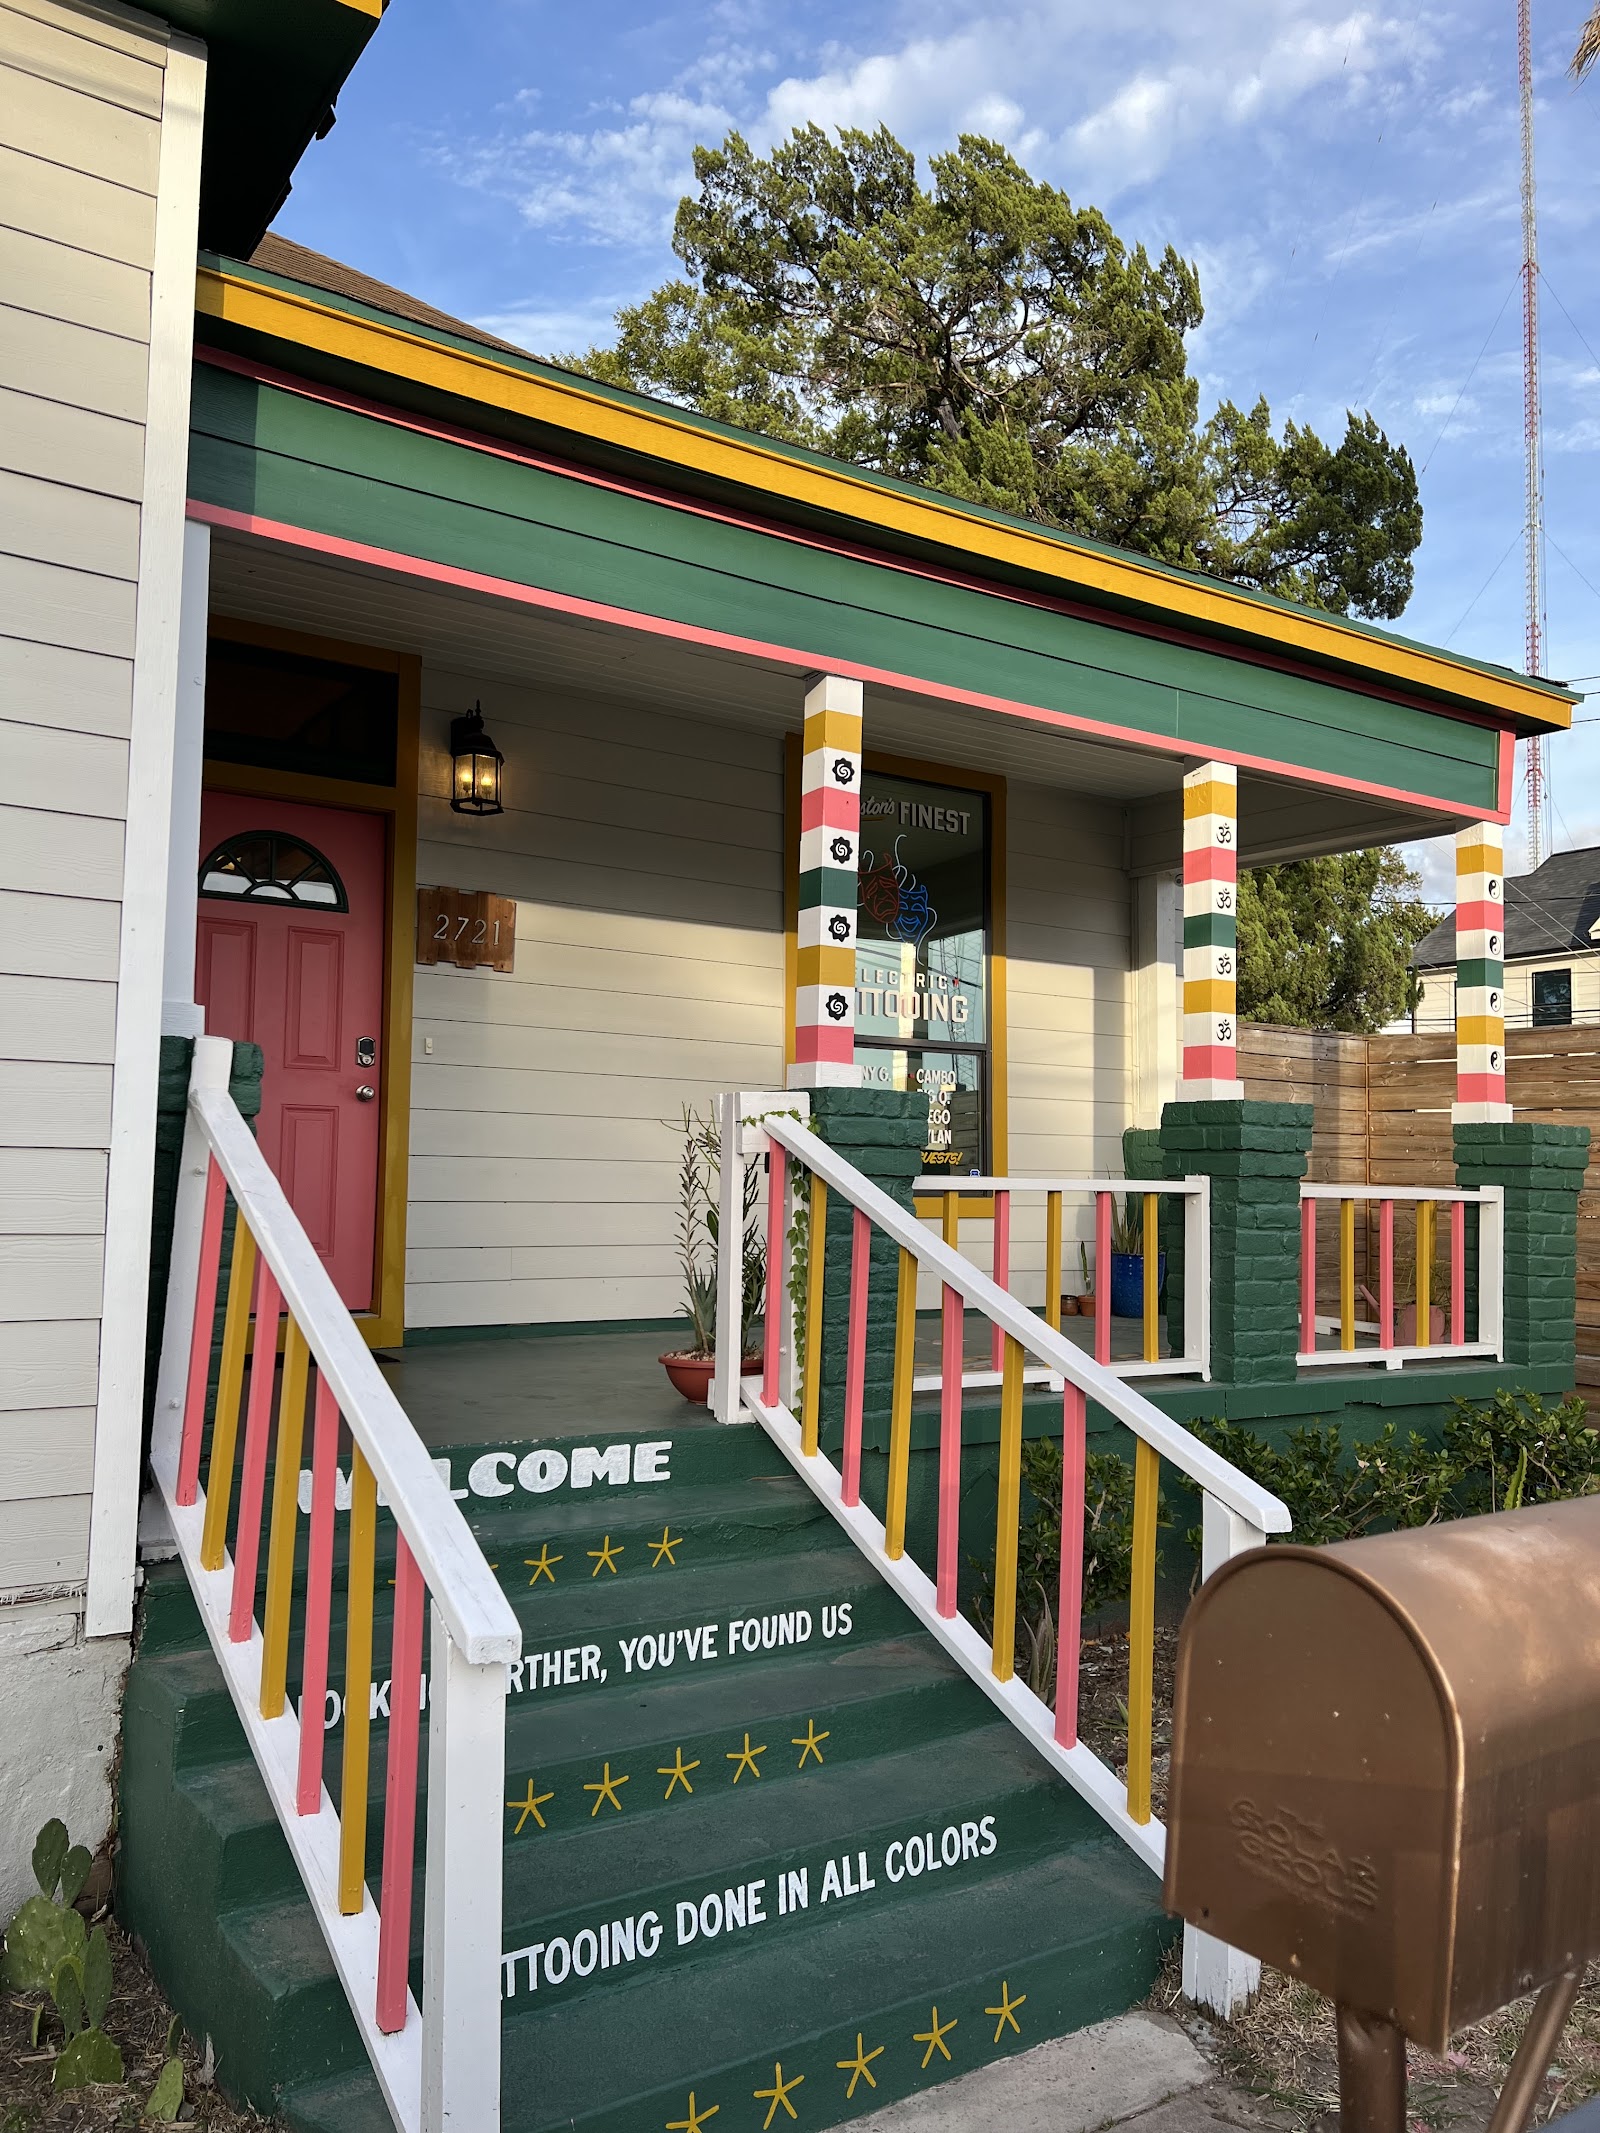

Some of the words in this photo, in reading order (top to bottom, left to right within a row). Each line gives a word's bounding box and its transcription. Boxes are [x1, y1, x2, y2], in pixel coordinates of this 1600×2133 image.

[860, 796, 895, 815] ston's
[899, 801, 971, 835] FINEST
[433, 914, 500, 946] 2721
[856, 968, 948, 990] LECTRIC
[855, 987, 969, 1023] TTOOING
[878, 1066, 892, 1081] G.
[916, 1068, 956, 1085] CAMBO
[928, 1109, 951, 1125] EGO
[298, 1441, 673, 1515] WLCOME
[506, 1644, 608, 1694] RTHER,
[618, 1624, 719, 1673] YOU'VE
[728, 1610, 812, 1654] FOUND
[821, 1602, 853, 1639] US
[500, 1912, 663, 2000] TTOOING
[676, 1879, 767, 1946] DONE
[778, 1867, 809, 1915] IN
[820, 1851, 877, 1903] ALL
[884, 1815, 998, 1883] COLORS
